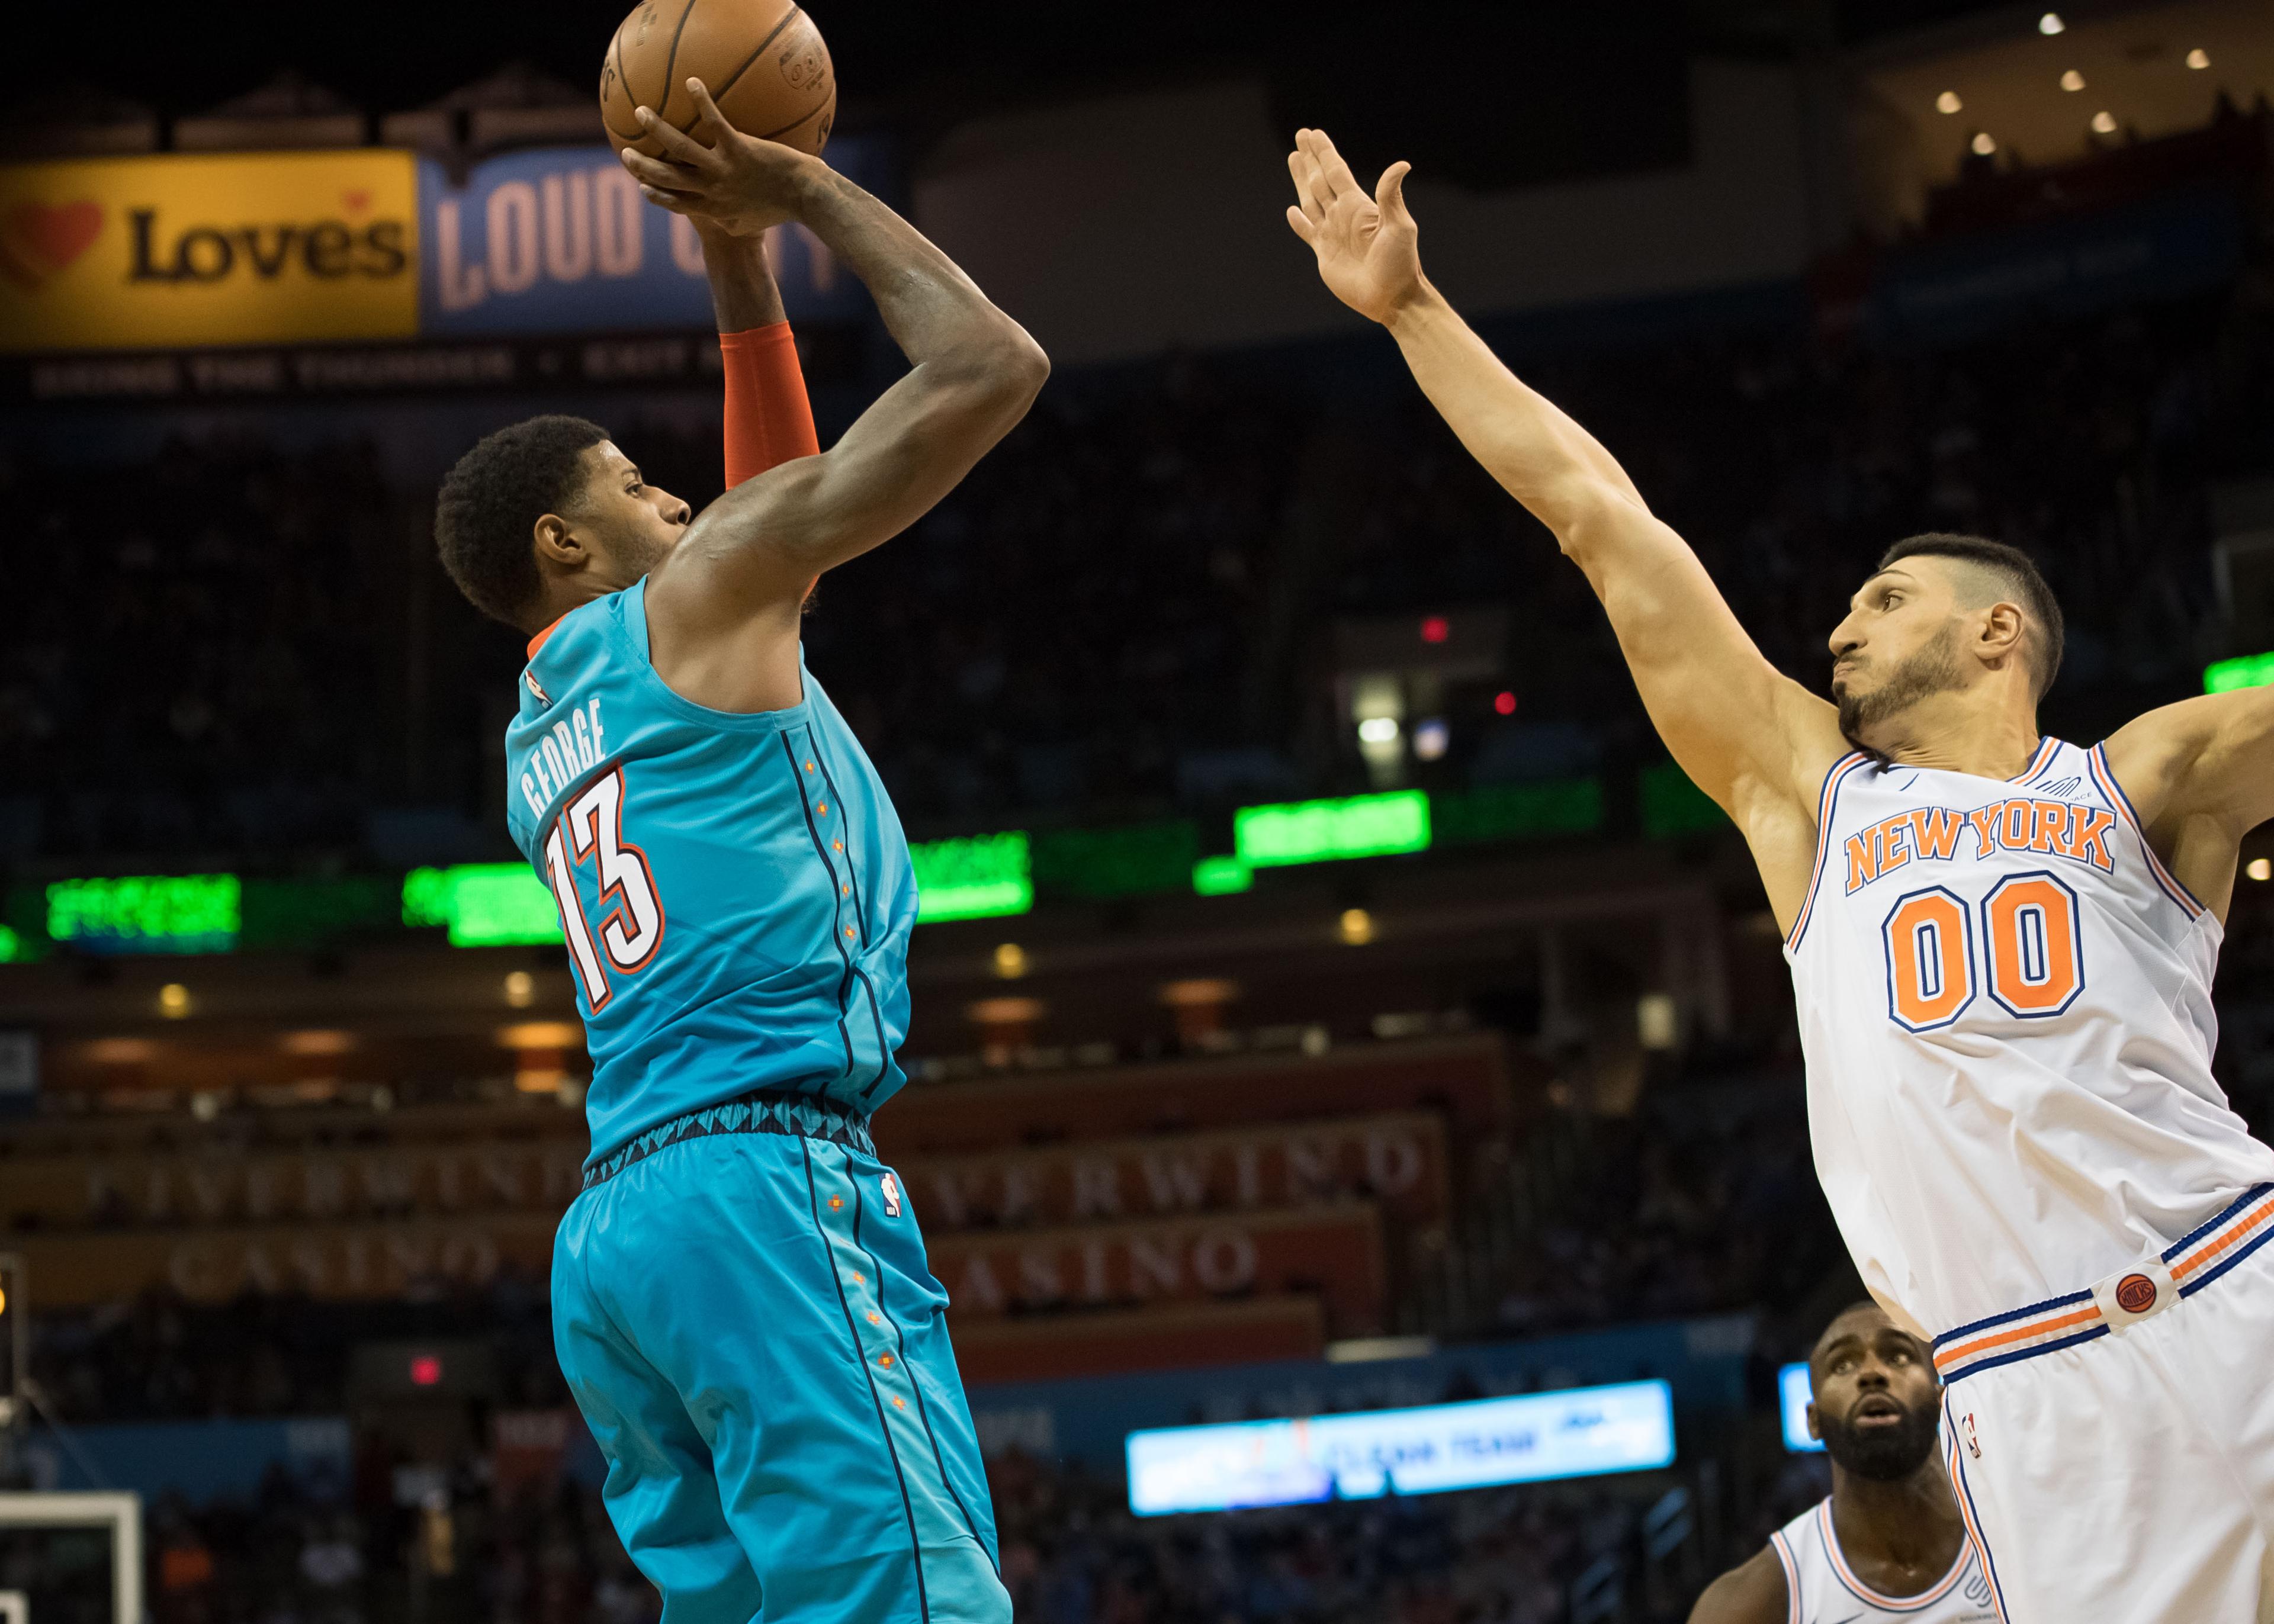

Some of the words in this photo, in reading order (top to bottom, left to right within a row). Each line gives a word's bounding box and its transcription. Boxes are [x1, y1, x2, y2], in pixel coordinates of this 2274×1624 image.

[437, 164, 645, 312] LOUD
[521, 697, 606, 821] GEORGE
[544, 758, 666, 1016] 13
[1845, 806, 1967, 897] NEW
[1967, 797, 2117, 874] YORK
[1881, 870, 2085, 1034] 00
[956, 1227, 1260, 1307] ASINO
[2121, 1283, 2153, 1305] KNICKS
